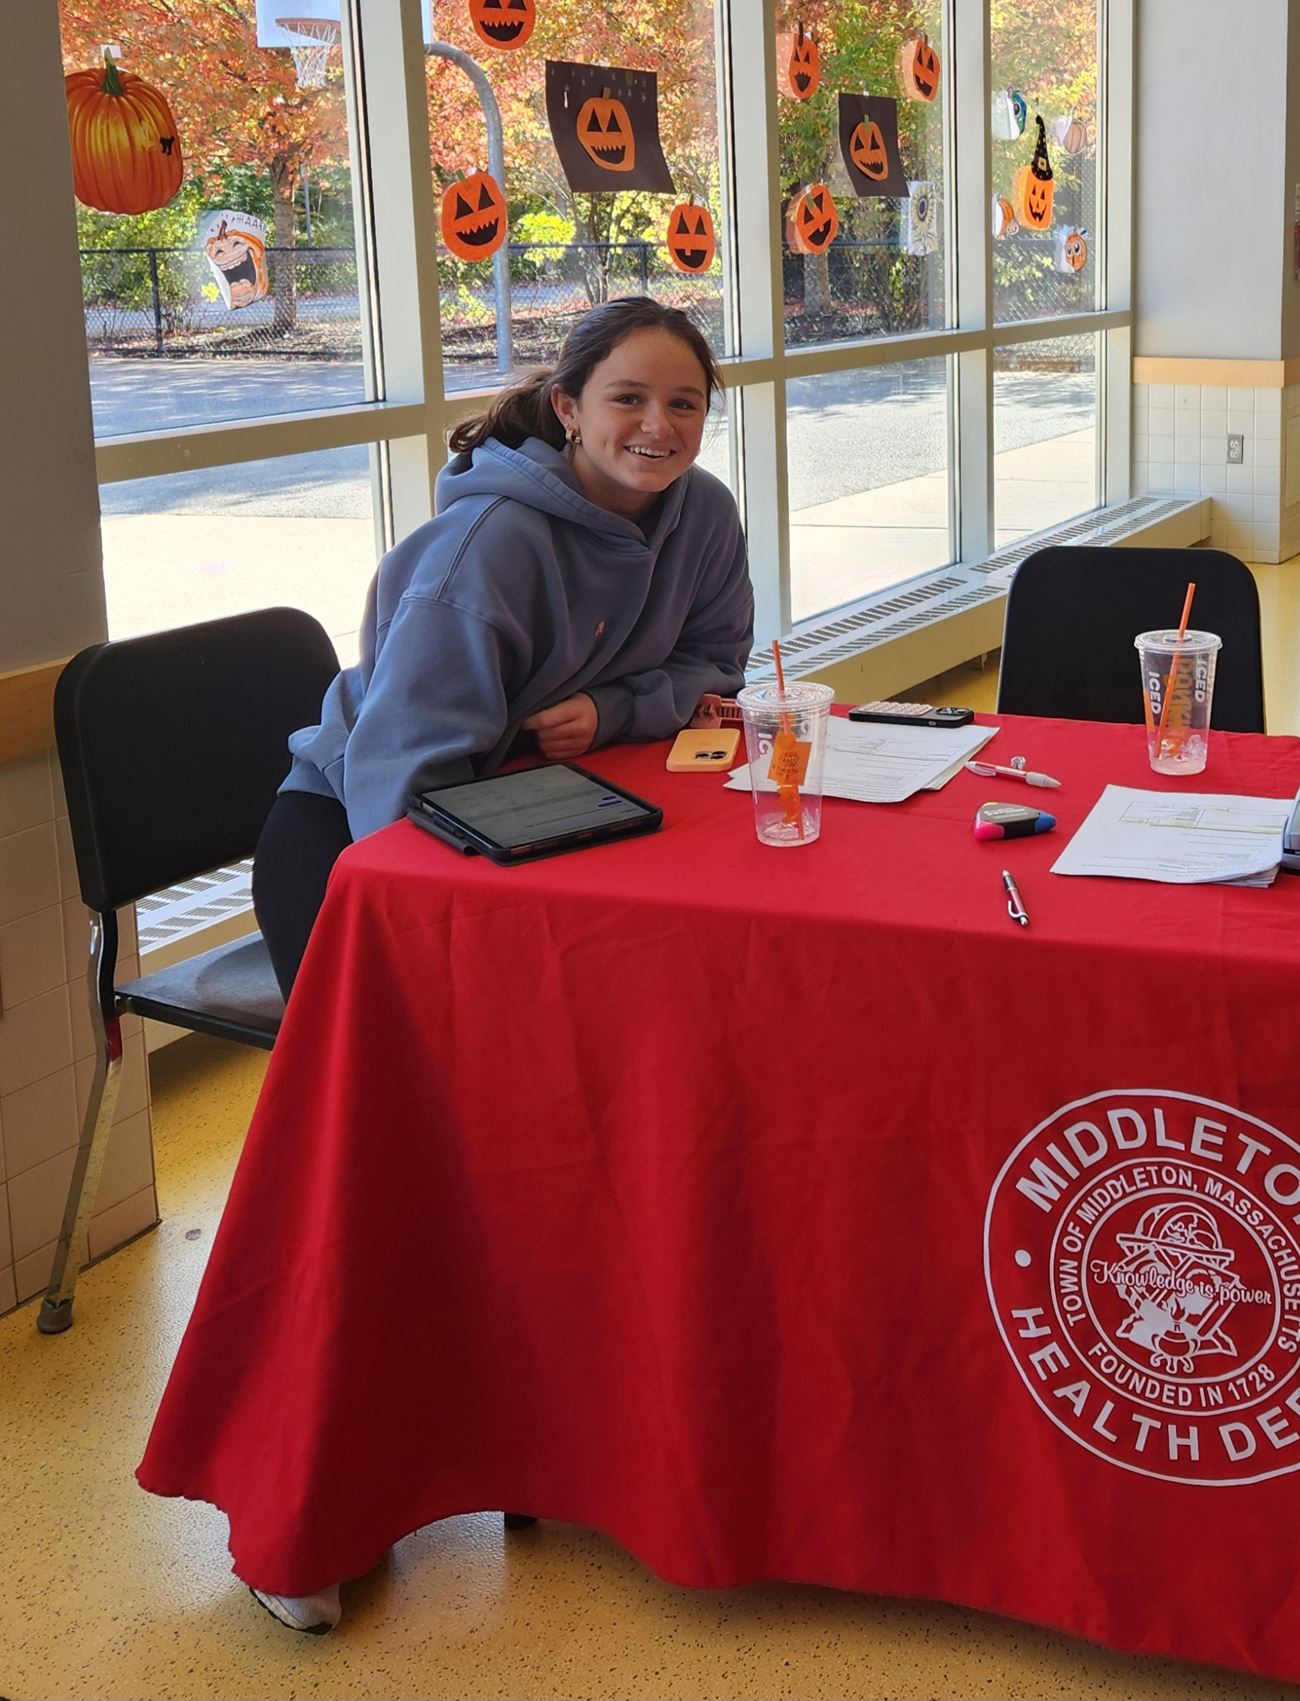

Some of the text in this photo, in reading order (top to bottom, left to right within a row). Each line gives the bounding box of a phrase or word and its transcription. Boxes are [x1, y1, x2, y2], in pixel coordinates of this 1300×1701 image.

[1149, 671, 1162, 715] ICED
[1195, 660, 1208, 703] ICED
[1063, 1222, 1087, 1254] OF
[1058, 1259, 1087, 1327] TOWN
[1090, 1259, 1272, 1306] Knowledge is power
[1011, 1306, 1200, 1461] HEALTH
[1088, 1343, 1276, 1407] FOUNDED IN 1728
